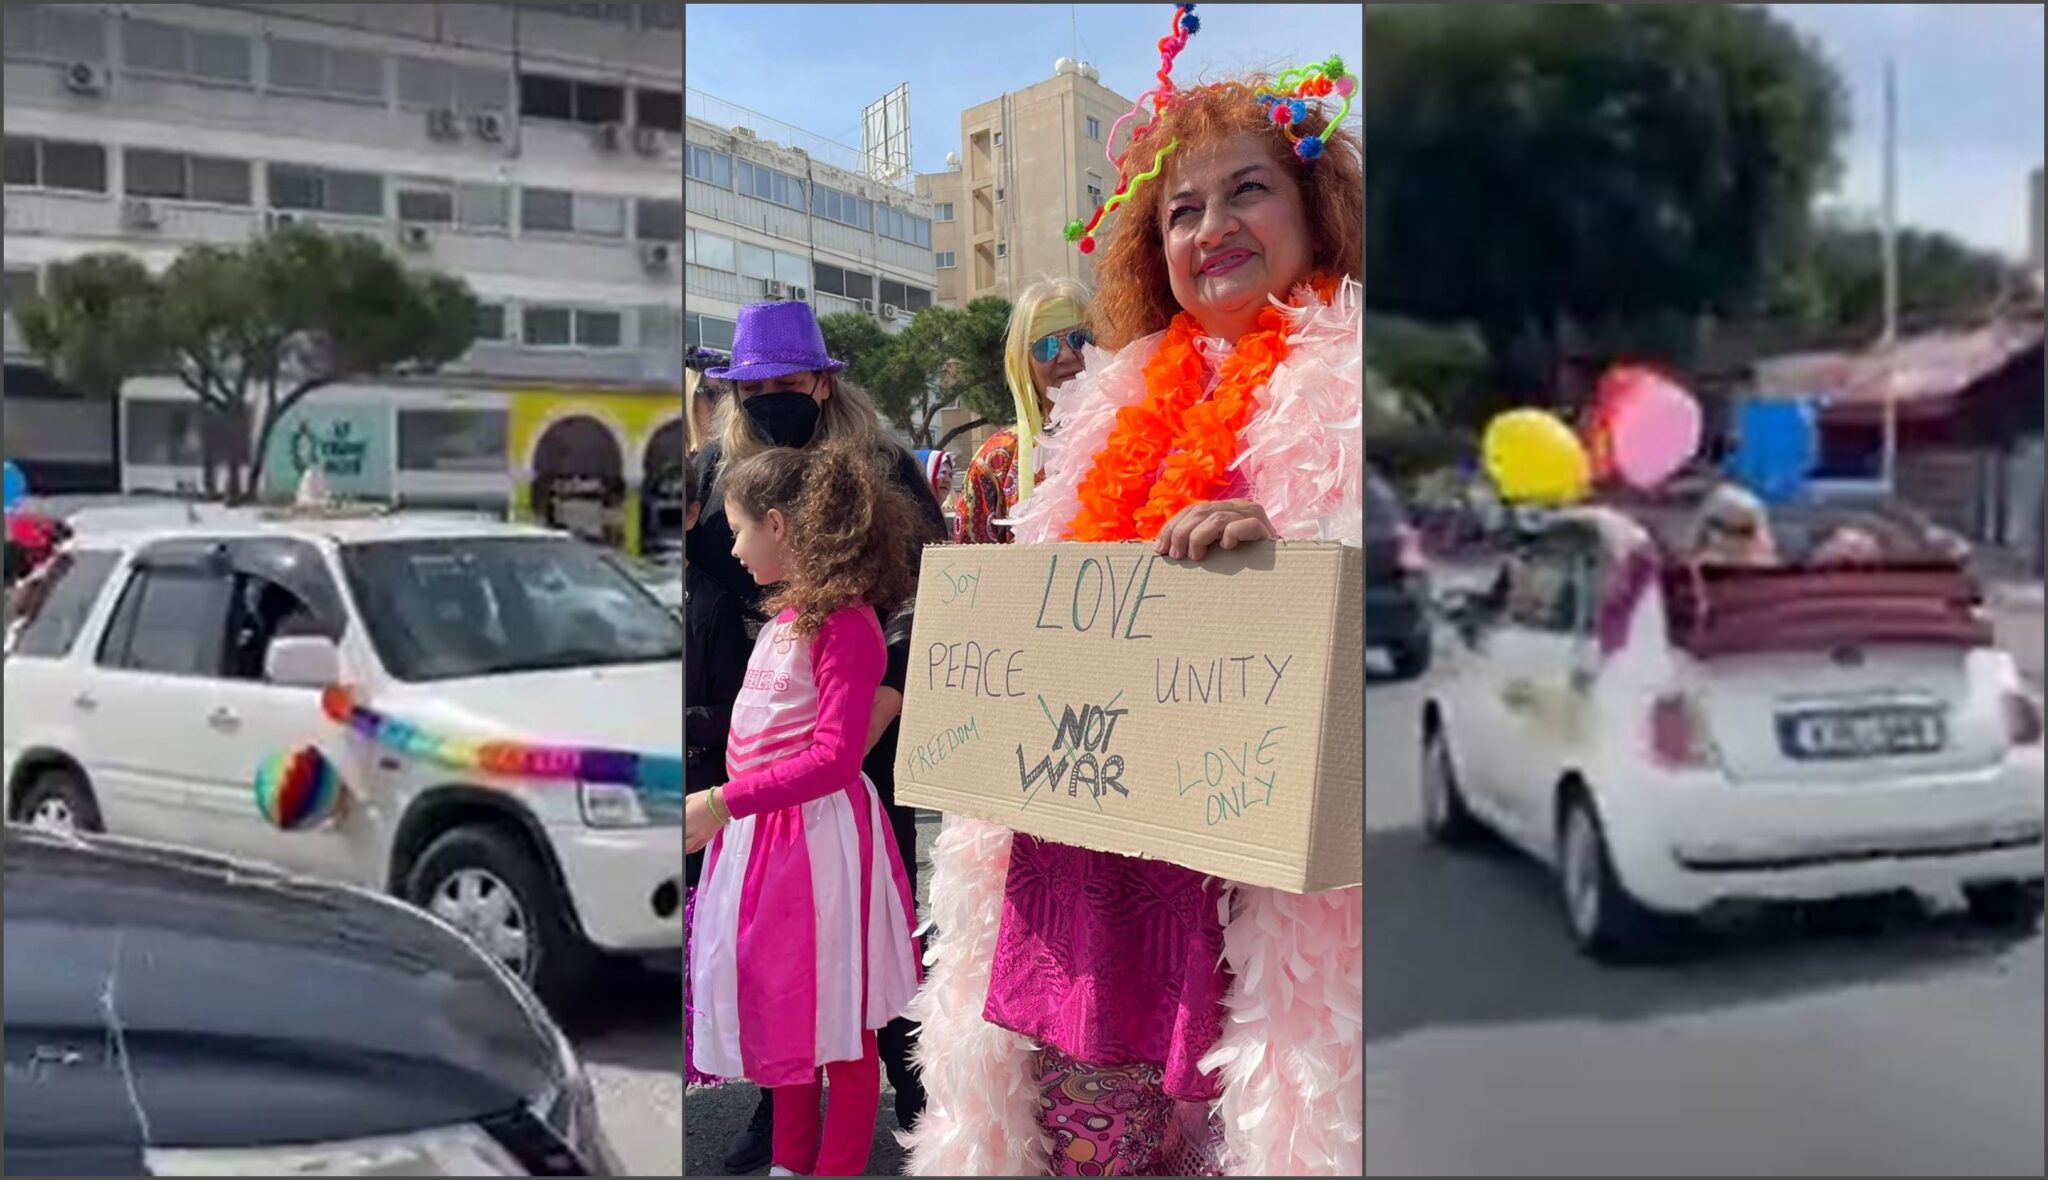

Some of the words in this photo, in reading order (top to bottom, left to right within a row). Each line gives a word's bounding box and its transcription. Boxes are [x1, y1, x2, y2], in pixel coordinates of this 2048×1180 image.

[1035, 553, 1167, 640] LOVE
[928, 640, 1026, 698] PEACE
[1156, 654, 1293, 705] UNITY
[906, 715, 981, 780] FREEDOM
[1052, 703, 1129, 753] NOT
[1016, 744, 1130, 798] WAR
[1177, 725, 1289, 797] LOVE
[1206, 771, 1277, 826] ONLY
